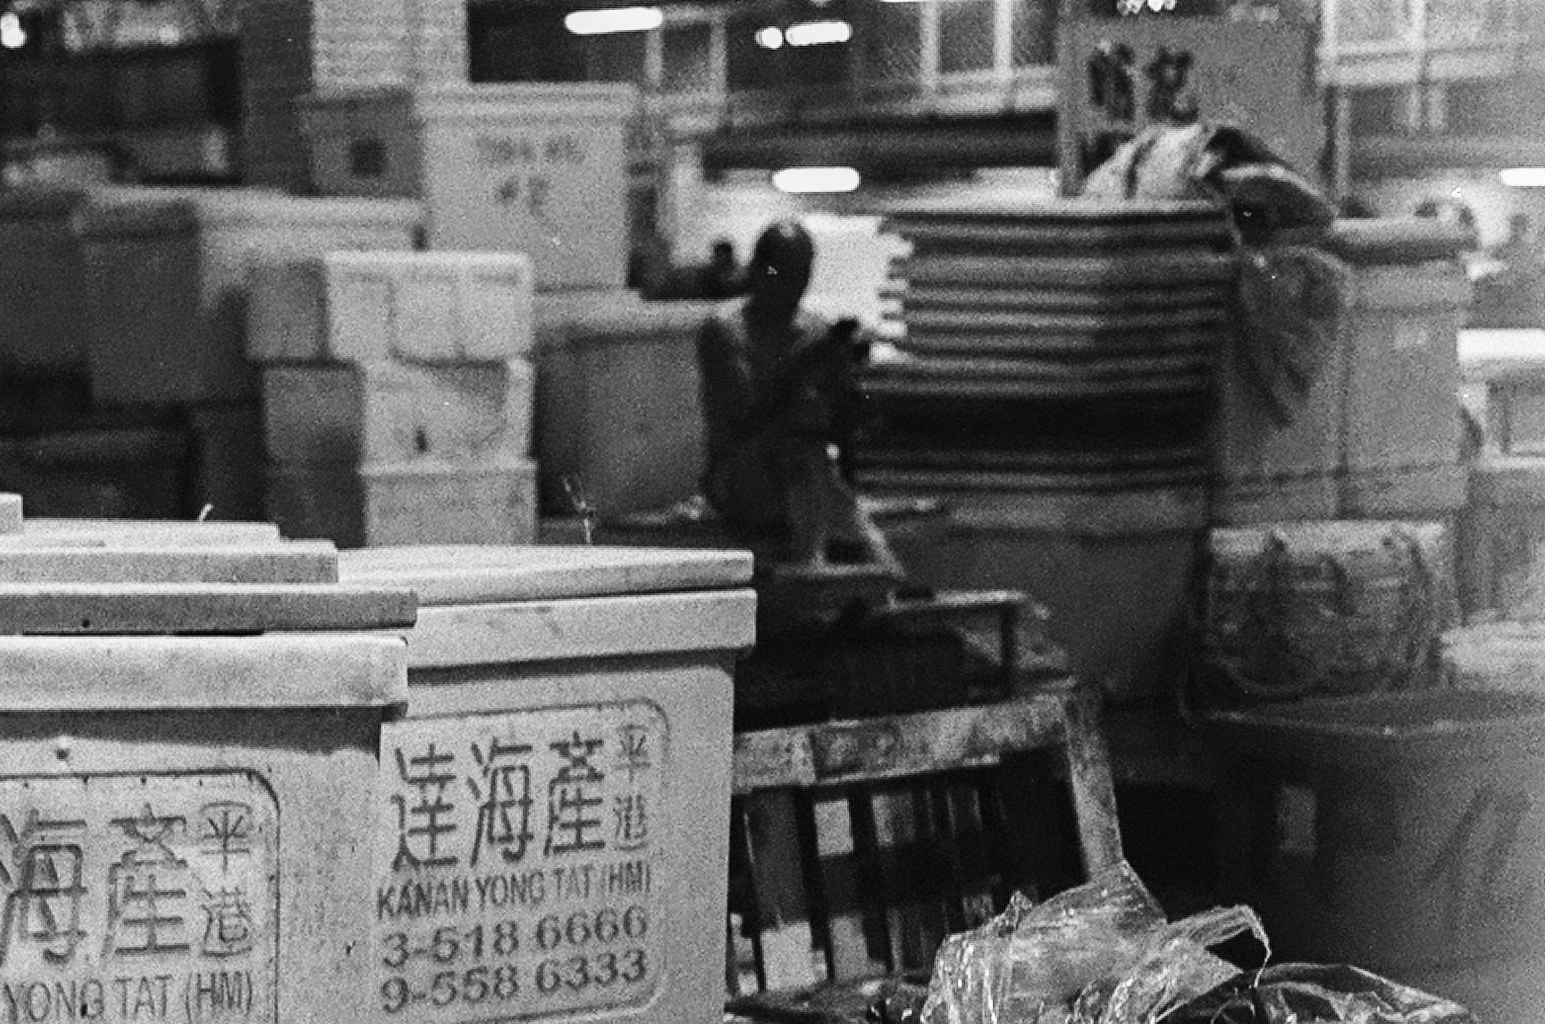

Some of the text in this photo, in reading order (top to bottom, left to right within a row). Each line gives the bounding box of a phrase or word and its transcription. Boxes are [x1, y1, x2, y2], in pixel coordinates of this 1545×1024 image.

[475, 871, 546, 912] YONG
[553, 865, 594, 898] TAT
[536, 905, 648, 952] 6666
[536, 948, 647, 995] 6333
[115, 975, 173, 1019] TAT
[185, 970, 254, 1024] (HM)
